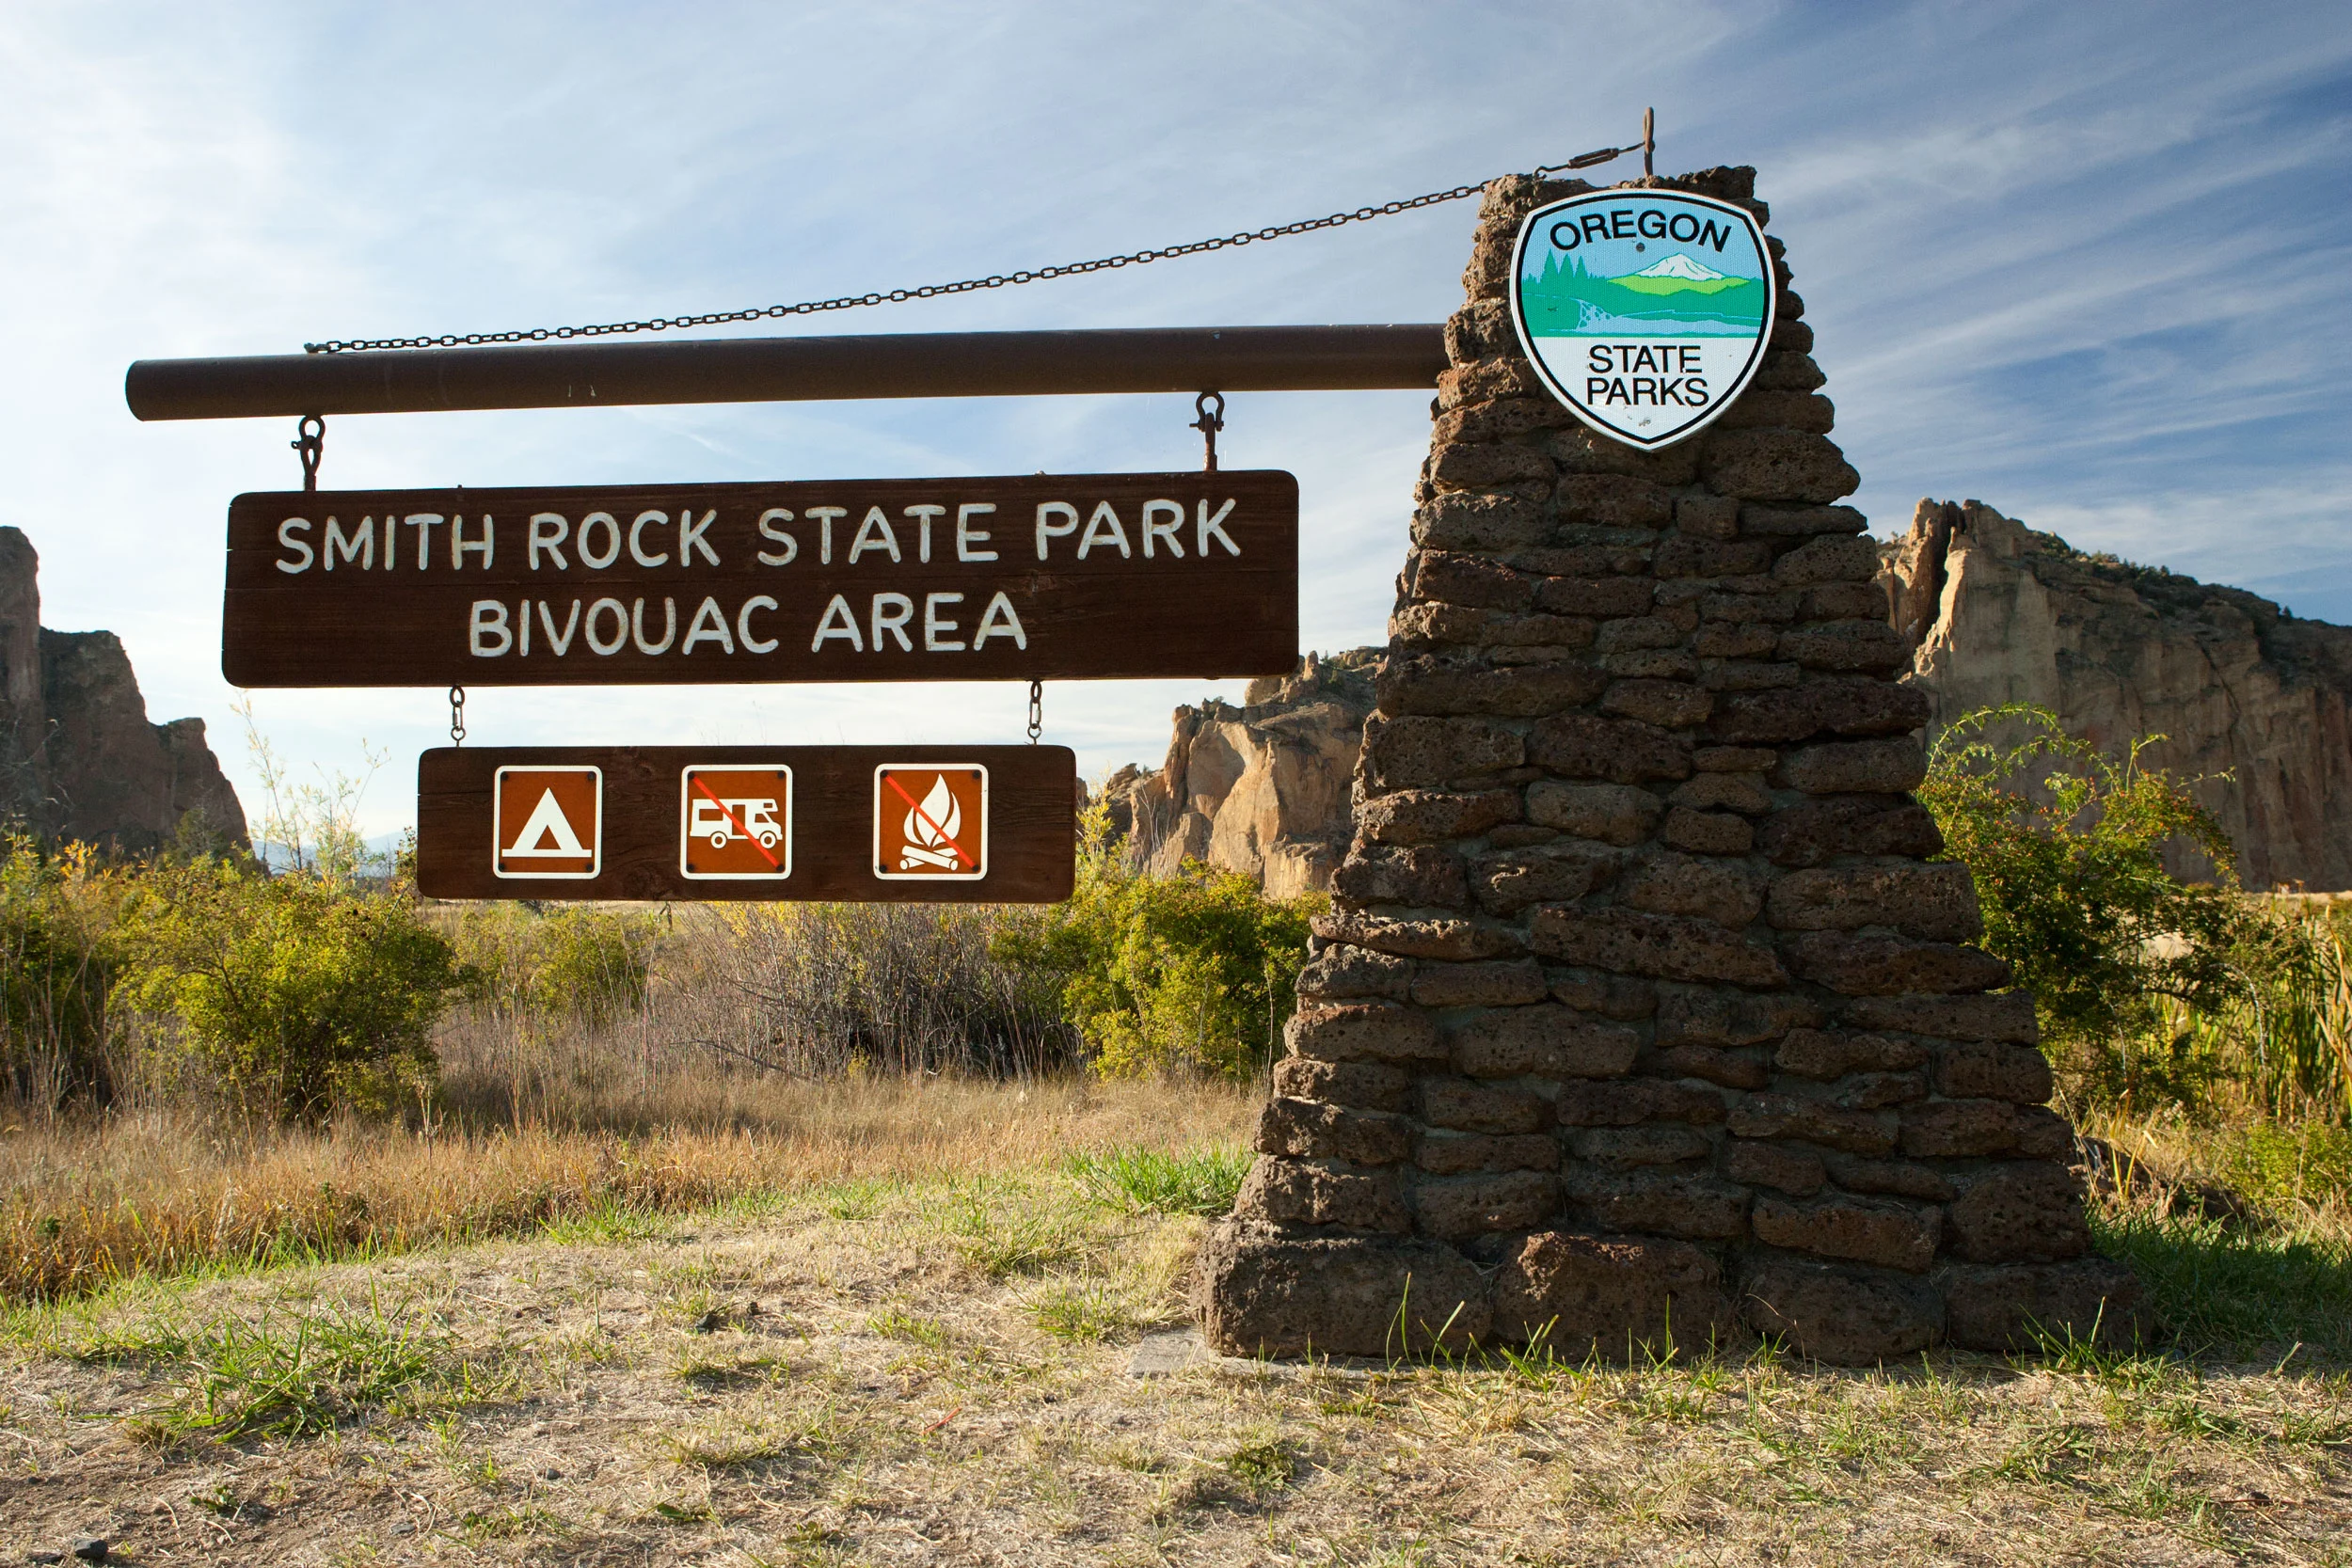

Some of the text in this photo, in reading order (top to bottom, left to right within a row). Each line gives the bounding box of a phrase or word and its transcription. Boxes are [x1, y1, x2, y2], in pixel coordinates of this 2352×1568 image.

[1549, 209, 1732, 253] OREGON
[1588, 344, 1703, 373] STATE
[1586, 377, 1709, 406] PARKS
[276, 498, 1241, 574] SMITH ROCK STATE PARK
[469, 591, 1027, 657] BIVOUAC AREA
